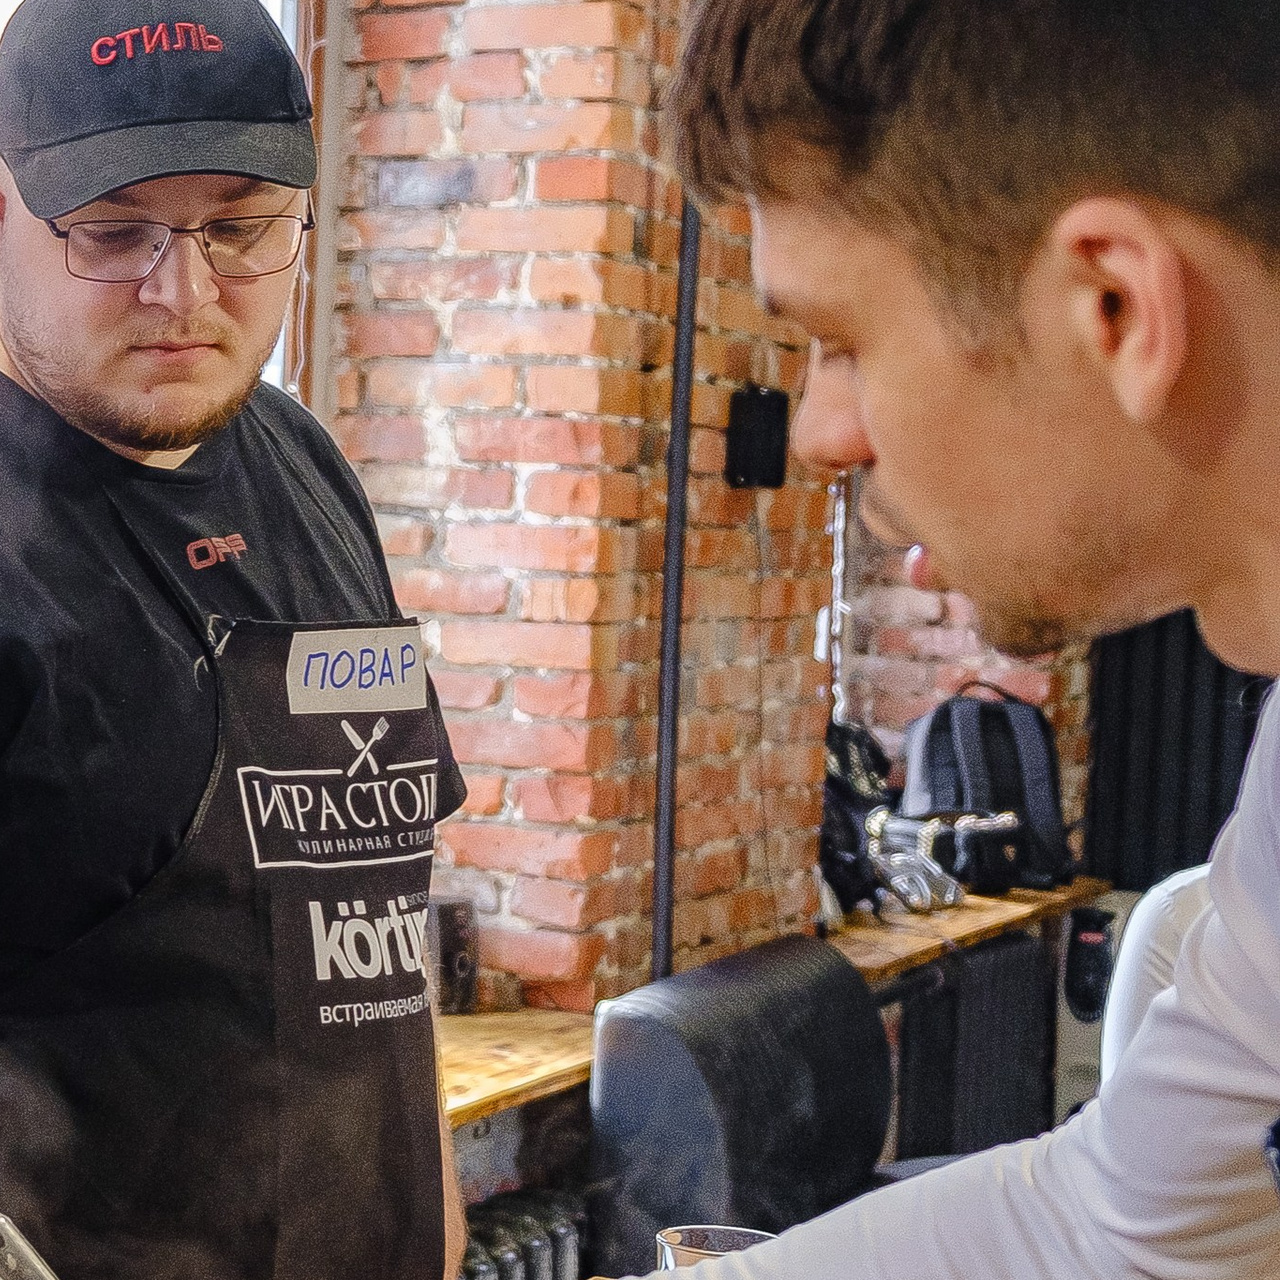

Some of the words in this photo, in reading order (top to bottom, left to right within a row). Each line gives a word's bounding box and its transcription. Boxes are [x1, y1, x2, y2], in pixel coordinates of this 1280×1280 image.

[90, 22, 224, 66] СТИЛЬ
[303, 643, 416, 690] ПОВАР
[251, 780, 348, 833] ИГРА
[345, 773, 439, 829] СТОЛ
